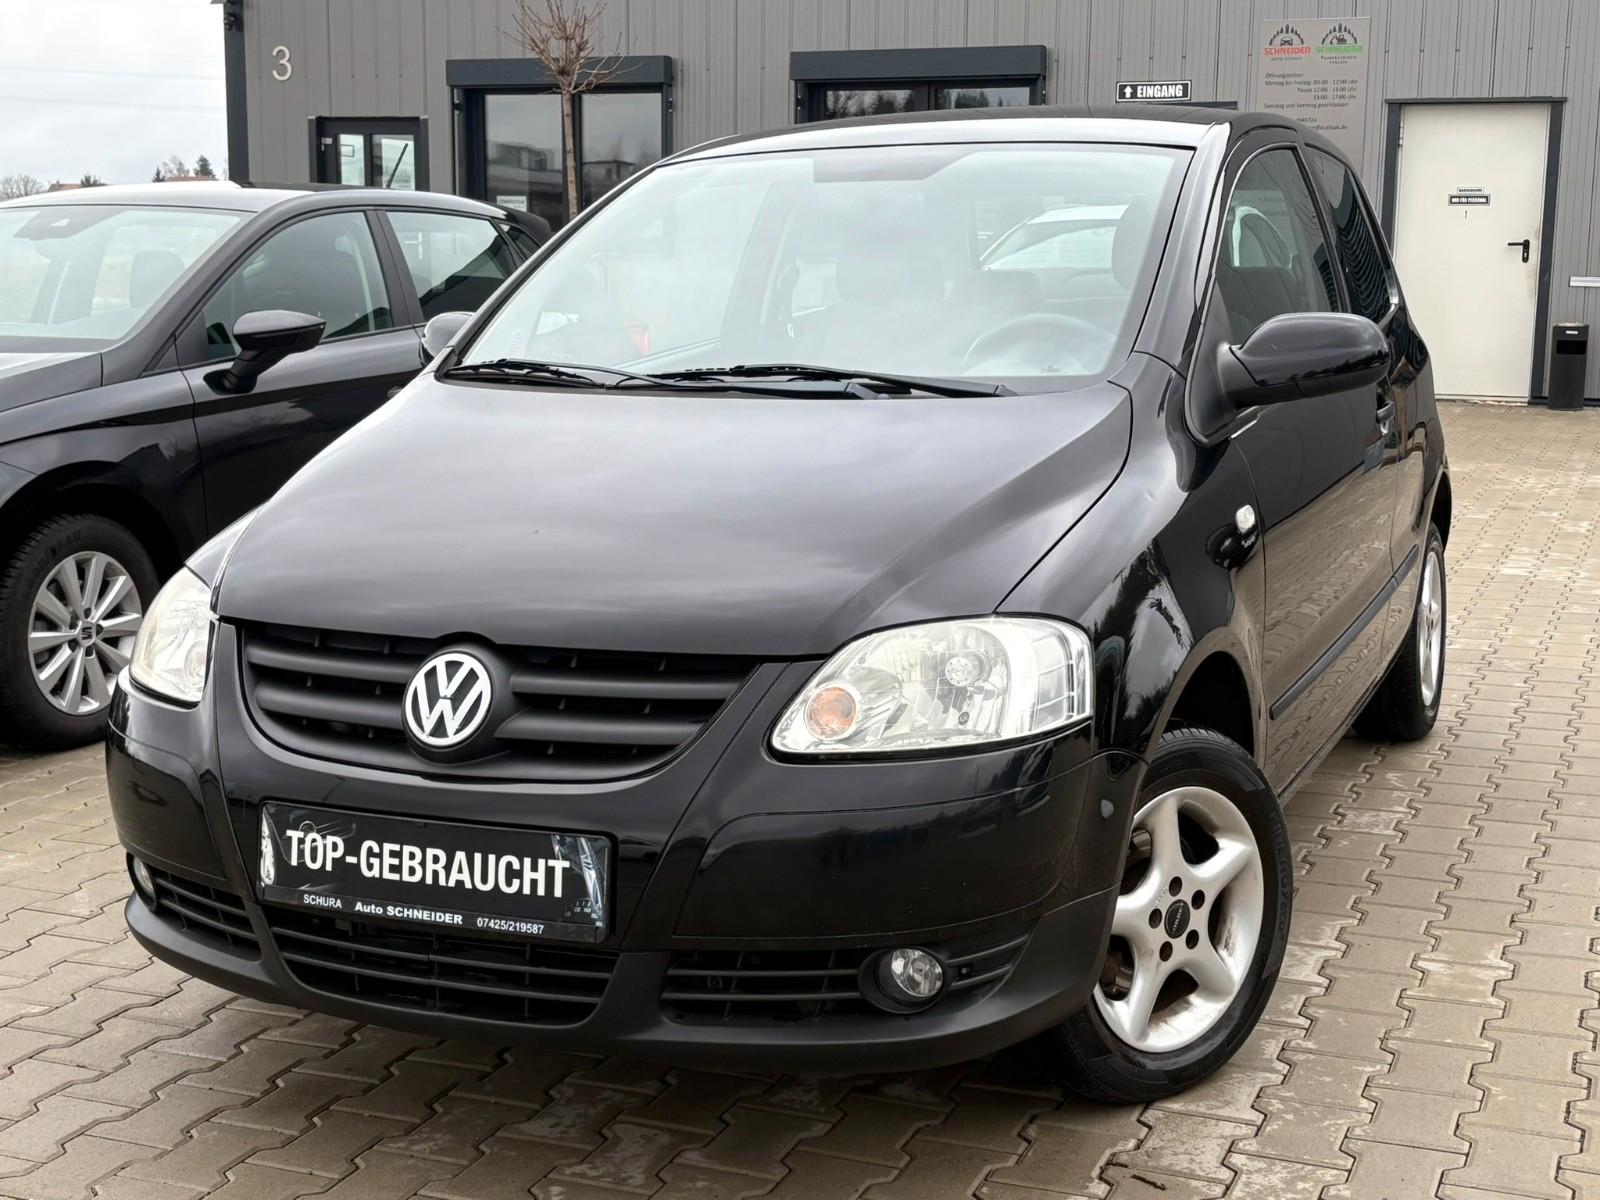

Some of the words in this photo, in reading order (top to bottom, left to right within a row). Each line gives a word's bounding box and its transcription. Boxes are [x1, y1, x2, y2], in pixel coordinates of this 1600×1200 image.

[272, 45, 292, 81] 3
[1264, 46, 1311, 55] SCHNEIDER
[1137, 84, 1183, 98] EINGANG
[286, 829, 570, 898] TOP-GEBRAUCHT
[303, 893, 343, 909] SCHURA
[355, 901, 383, 915] Auto
[386, 905, 463, 925] SCHNEIDER
[476, 917, 545, 935] 07425/219587
